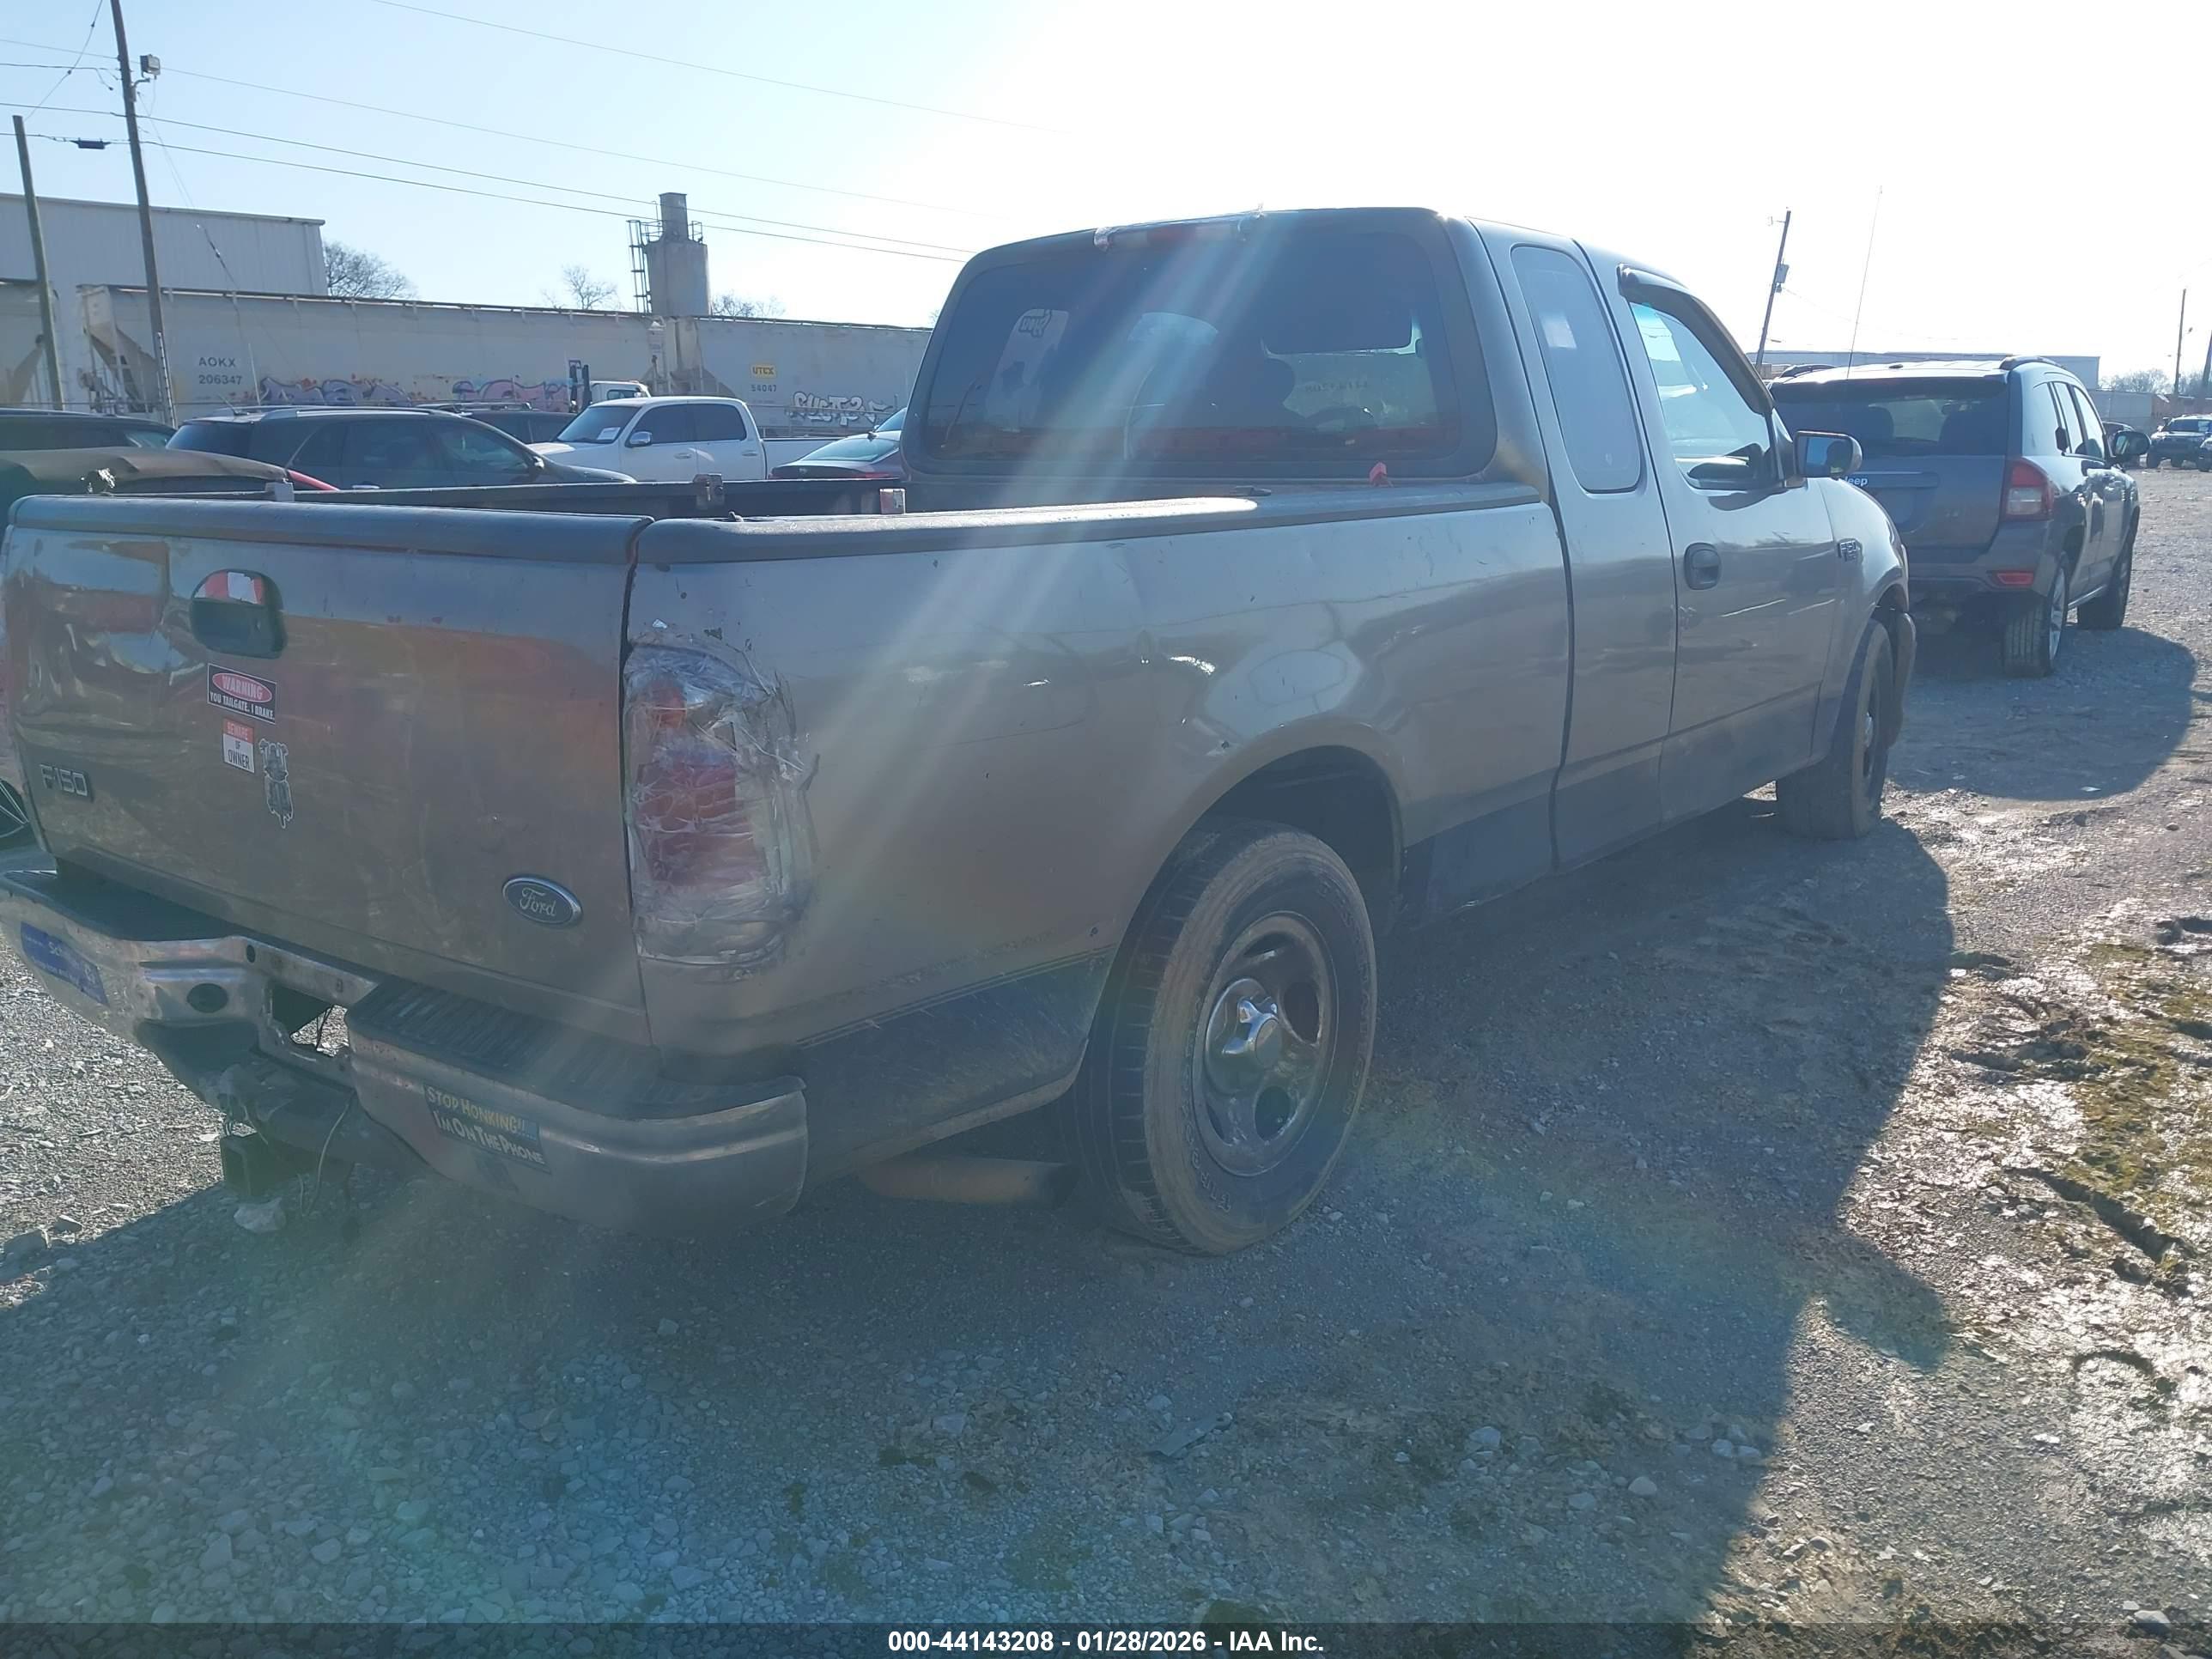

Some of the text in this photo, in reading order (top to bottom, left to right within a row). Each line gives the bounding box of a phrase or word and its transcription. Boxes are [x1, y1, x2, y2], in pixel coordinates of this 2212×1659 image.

[198, 356, 236, 368] AOKX
[198, 374, 243, 386] 206347
[210, 691, 222, 703] YOU
[222, 675, 264, 701] WARNING
[228, 749, 250, 769] OWNER
[519, 886, 557, 917] Ford
[427, 1086, 459, 1111] STOP
[497, 1133, 546, 1165] PHONE
